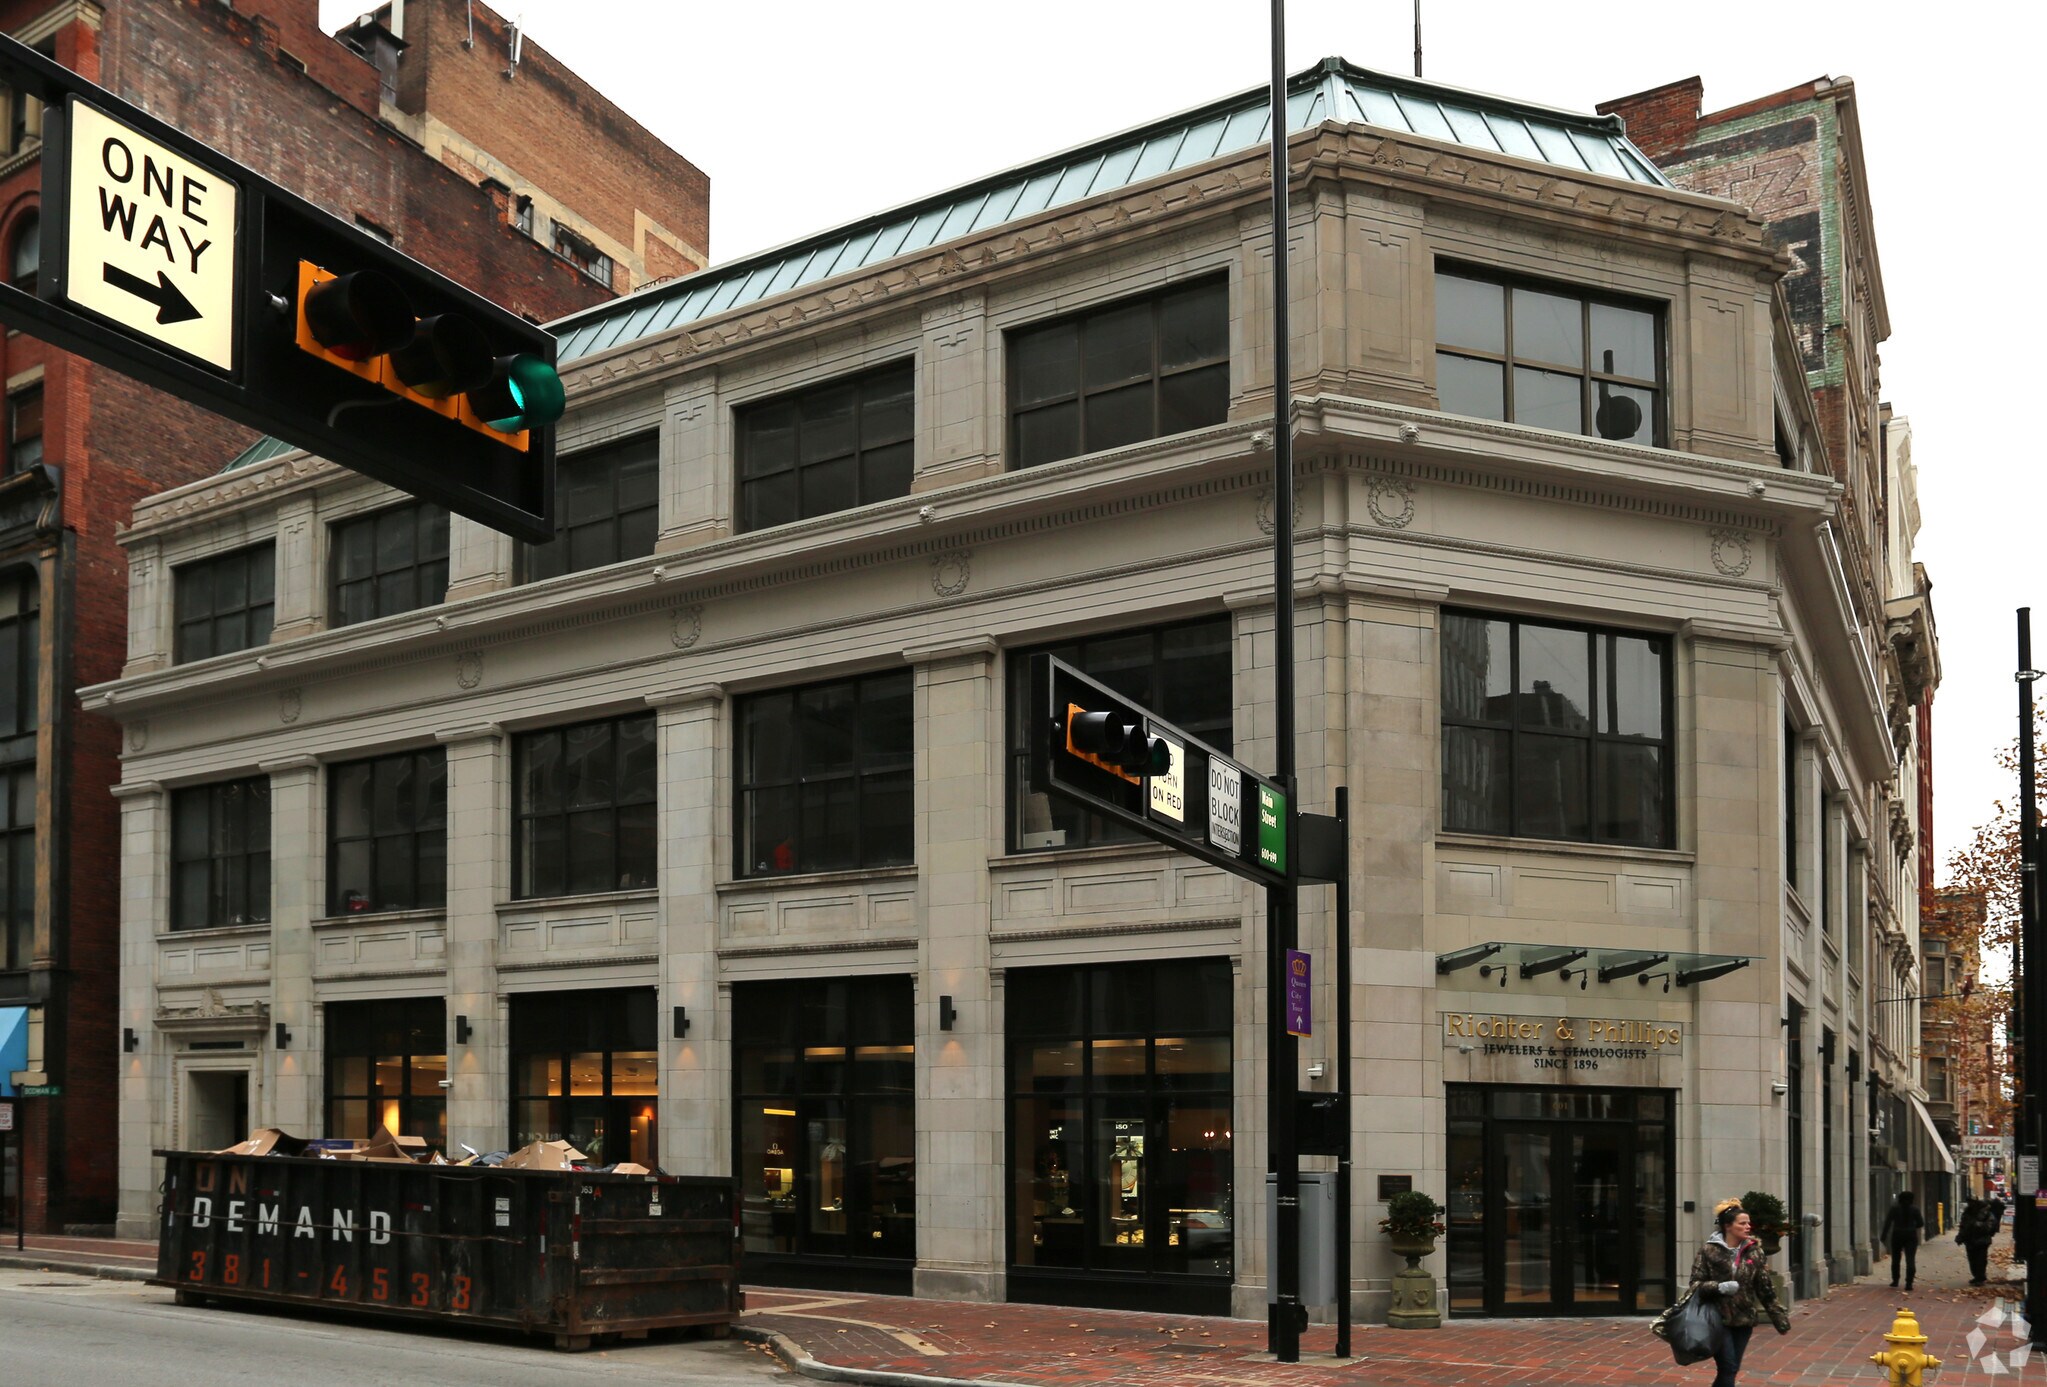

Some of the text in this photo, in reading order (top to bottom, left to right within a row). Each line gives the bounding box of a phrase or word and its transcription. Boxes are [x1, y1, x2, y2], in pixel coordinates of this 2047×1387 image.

[102, 137, 208, 227] ONE
[98, 185, 212, 275] WAY
[1212, 769, 1239, 799] DO NOT
[1153, 786, 1181, 810] ON RED
[1212, 796, 1239, 827] BLOCK
[1261, 790, 1273, 809] Main
[1261, 808, 1277, 829] Street
[1291, 977, 1306, 988] Queen
[1291, 990, 1301, 1001] City
[1292, 1003, 1303, 1012] Tour
[1447, 1013, 1681, 1050] Richter & Phillips
[1483, 1044, 1647, 1059] JEWELERS & GEMOLOGISTS
[1534, 1058, 1598, 1070] SINCE 1896
[196, 1161, 247, 1195] ON
[192, 1197, 391, 1245] DEMAND
[190, 1251, 471, 1310] 381-4533
